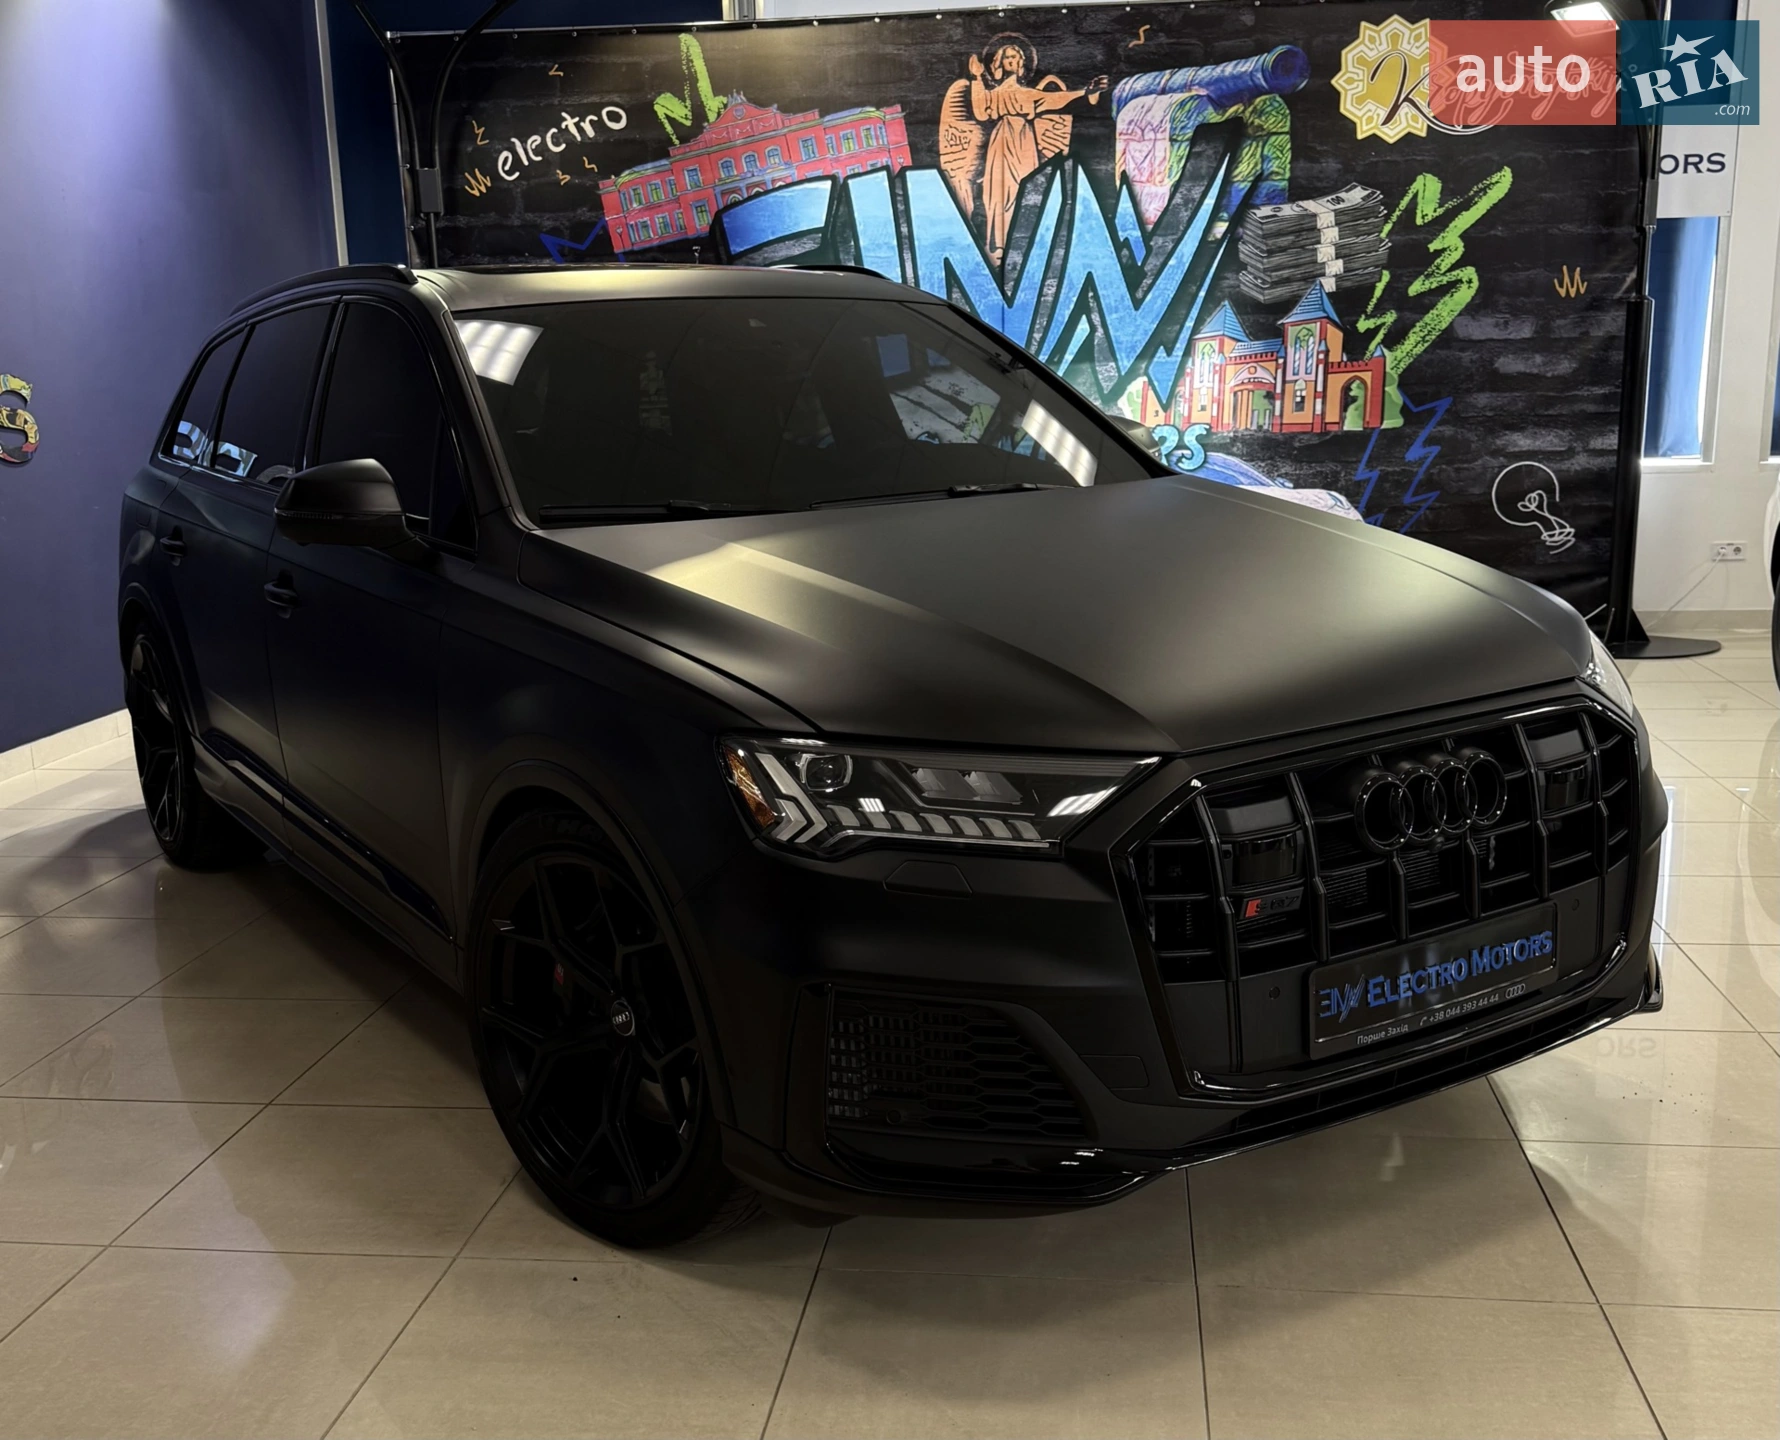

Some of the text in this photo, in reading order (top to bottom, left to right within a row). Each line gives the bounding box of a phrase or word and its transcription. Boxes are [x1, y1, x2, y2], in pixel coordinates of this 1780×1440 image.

[497, 105, 628, 182] electro
[1367, 957, 1468, 1008] ELECTRO
[1470, 930, 1553, 977] MOTORS
[1356, 993, 1499, 1045] Порше Захід +38 044 393 44 44
